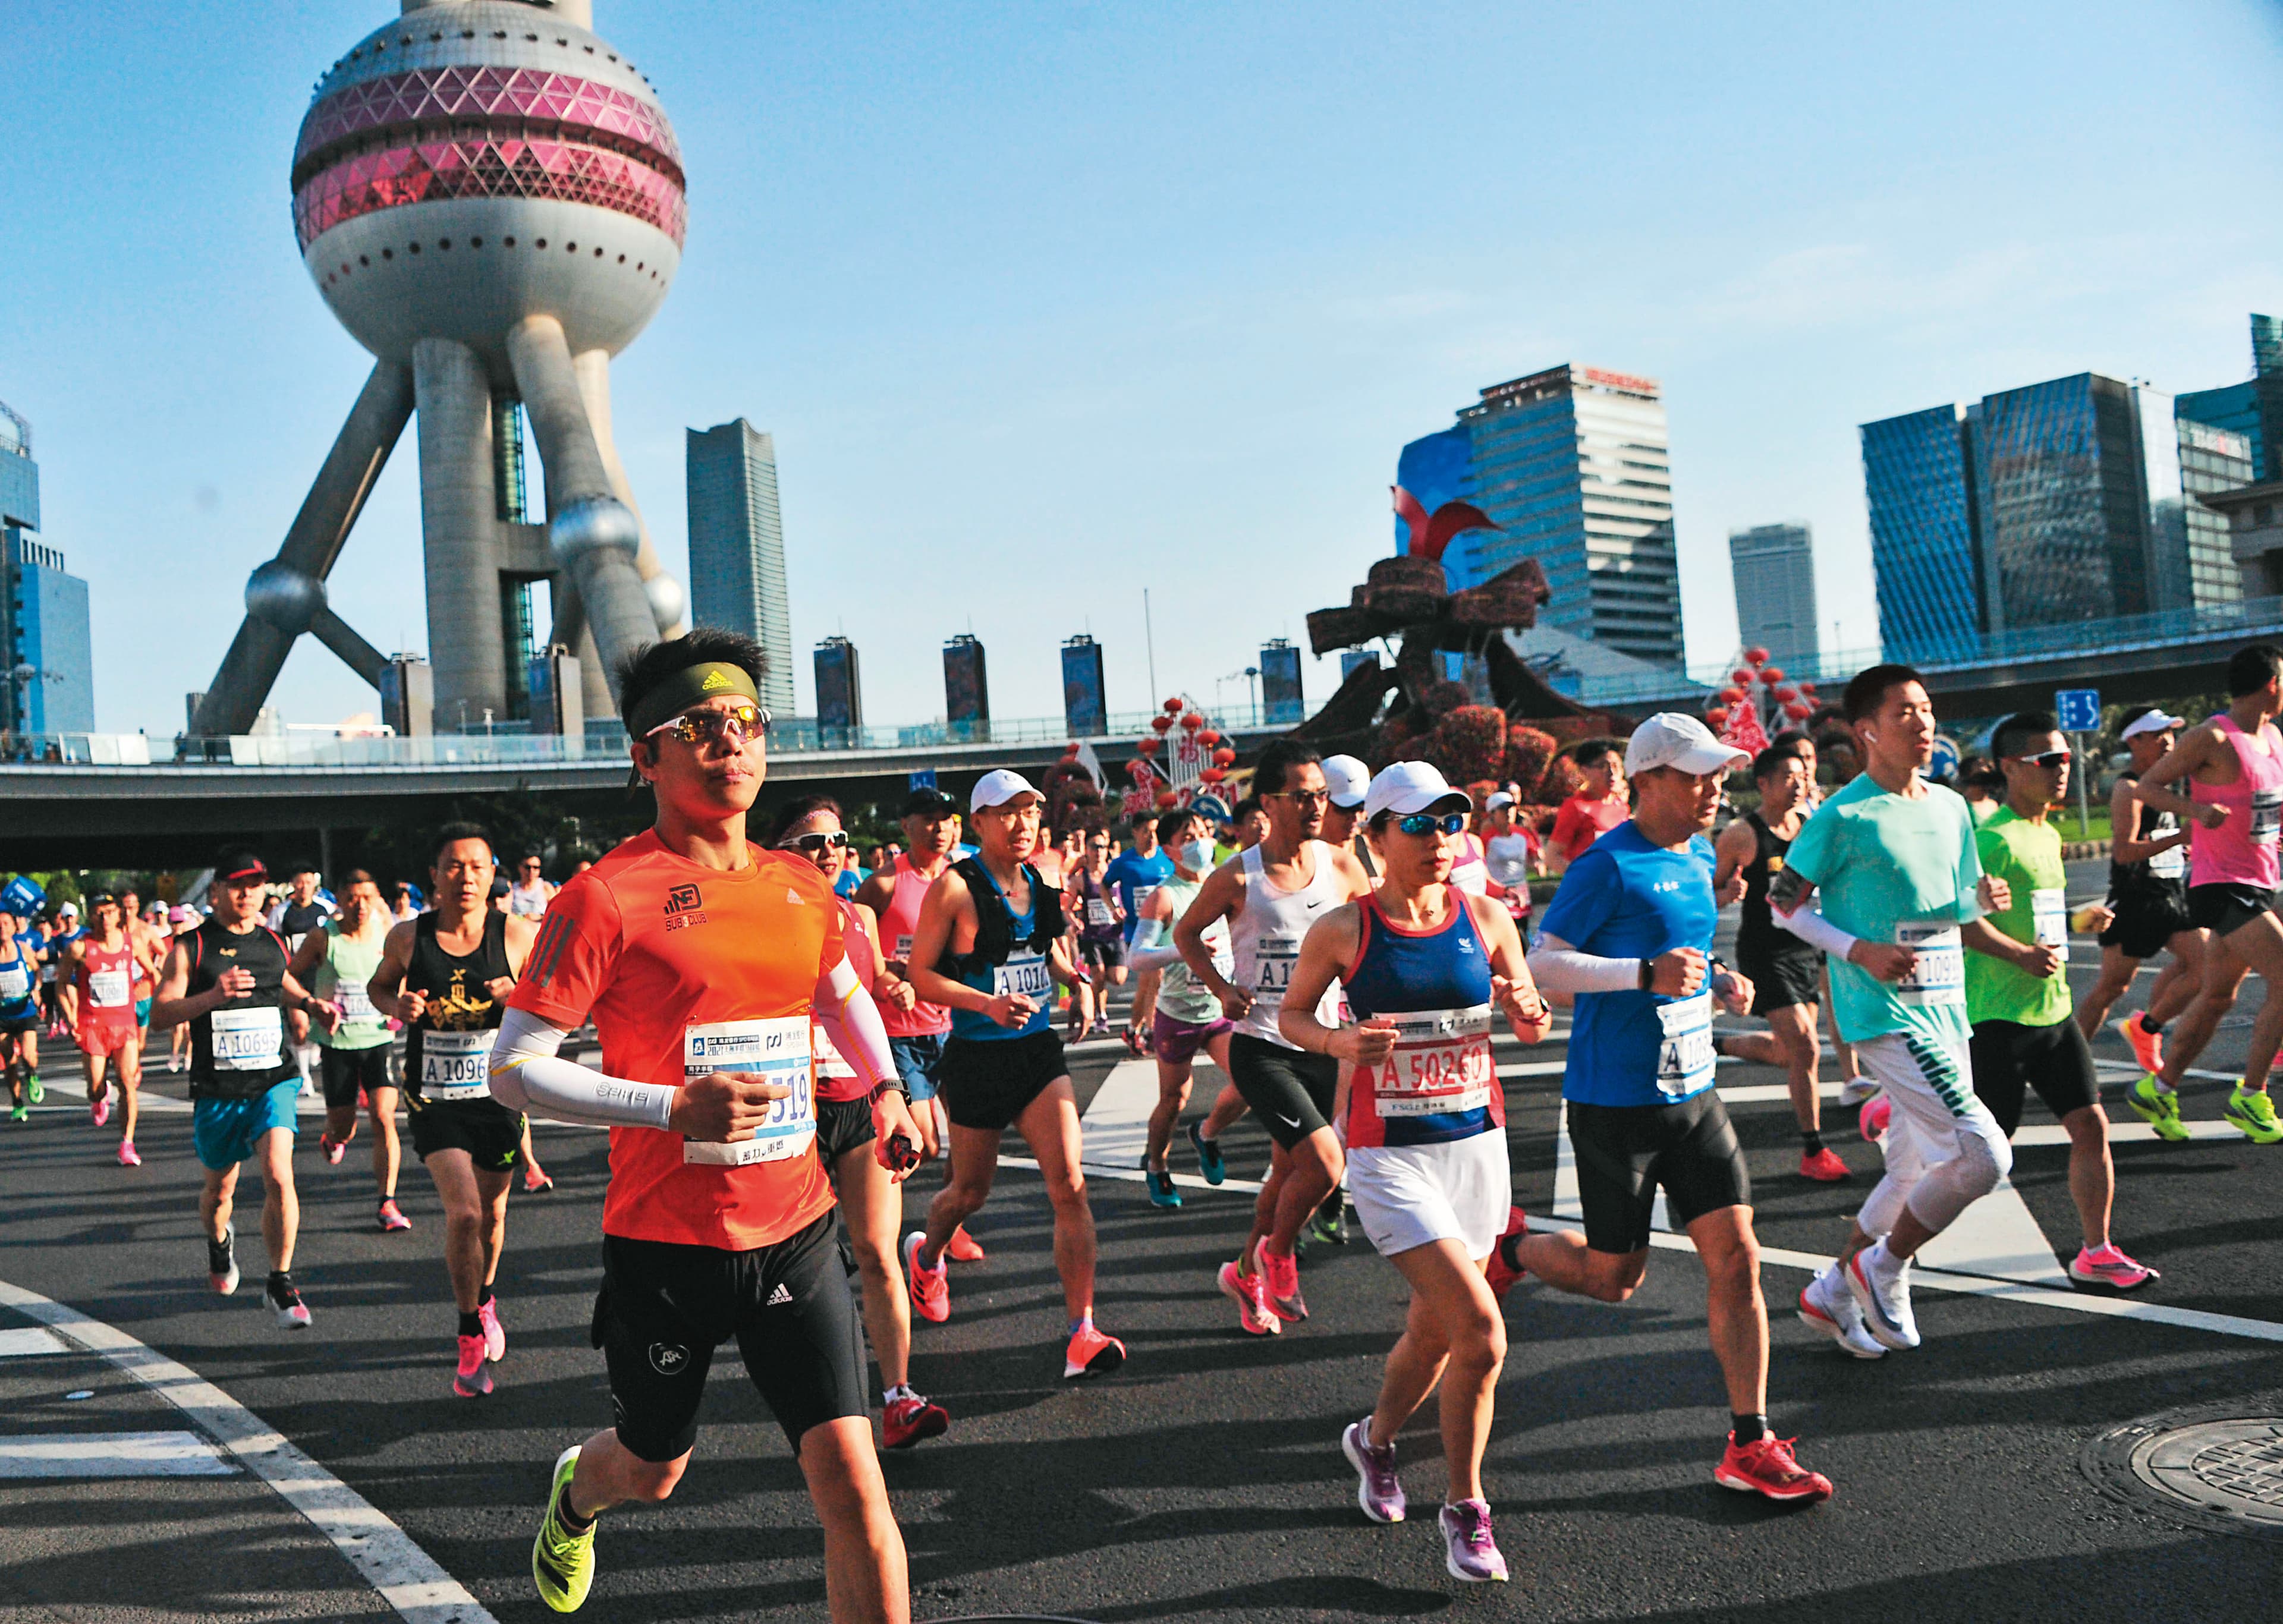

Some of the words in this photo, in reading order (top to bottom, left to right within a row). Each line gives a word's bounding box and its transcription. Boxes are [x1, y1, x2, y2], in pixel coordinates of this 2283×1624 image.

[702, 680, 734, 690] adidas
[1262, 962, 1274, 986] A
[218, 1036, 228, 1054] A
[234, 1033, 277, 1053] 10695
[426, 1058, 438, 1080] A
[1382, 1055, 1401, 1088] A
[1410, 1046, 1483, 1089] 50260
[1664, 1043, 1680, 1072] A
[764, 1074, 808, 1123] 519
[766, 1295, 794, 1306] adidas
